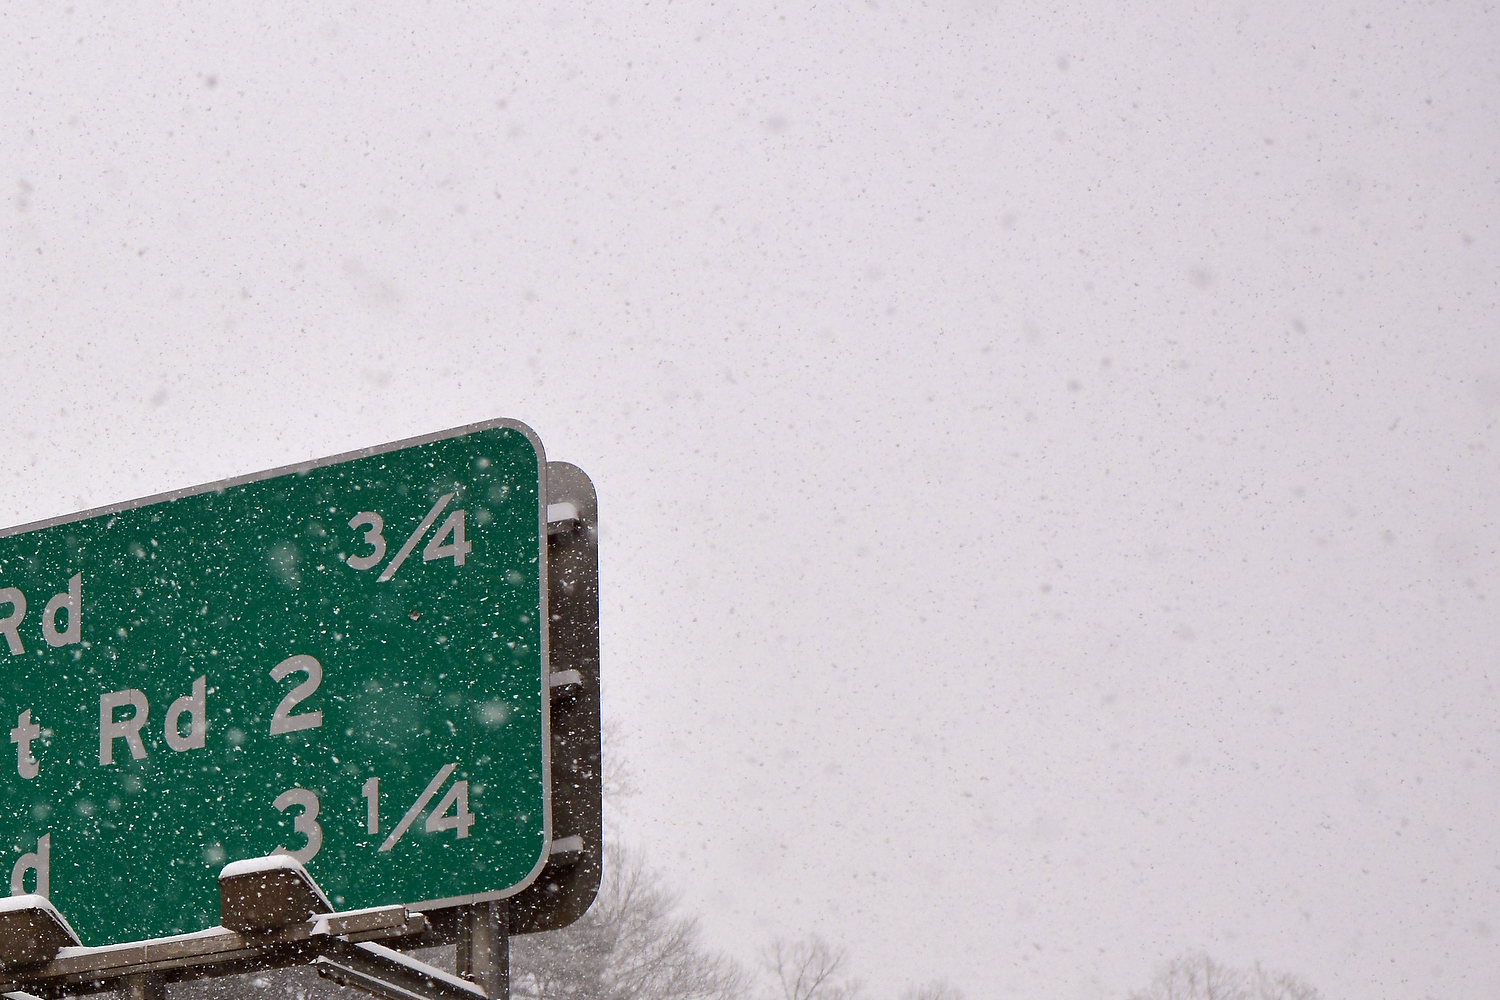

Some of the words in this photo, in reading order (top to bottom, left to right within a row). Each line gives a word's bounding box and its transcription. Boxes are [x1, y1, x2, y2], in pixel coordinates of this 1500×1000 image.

[346, 492, 472, 583] 3/4
[99, 674, 206, 766] Rd
[269, 654, 323, 736] 2
[270, 787, 323, 865] 3
[362, 762, 476, 853] 1/4
